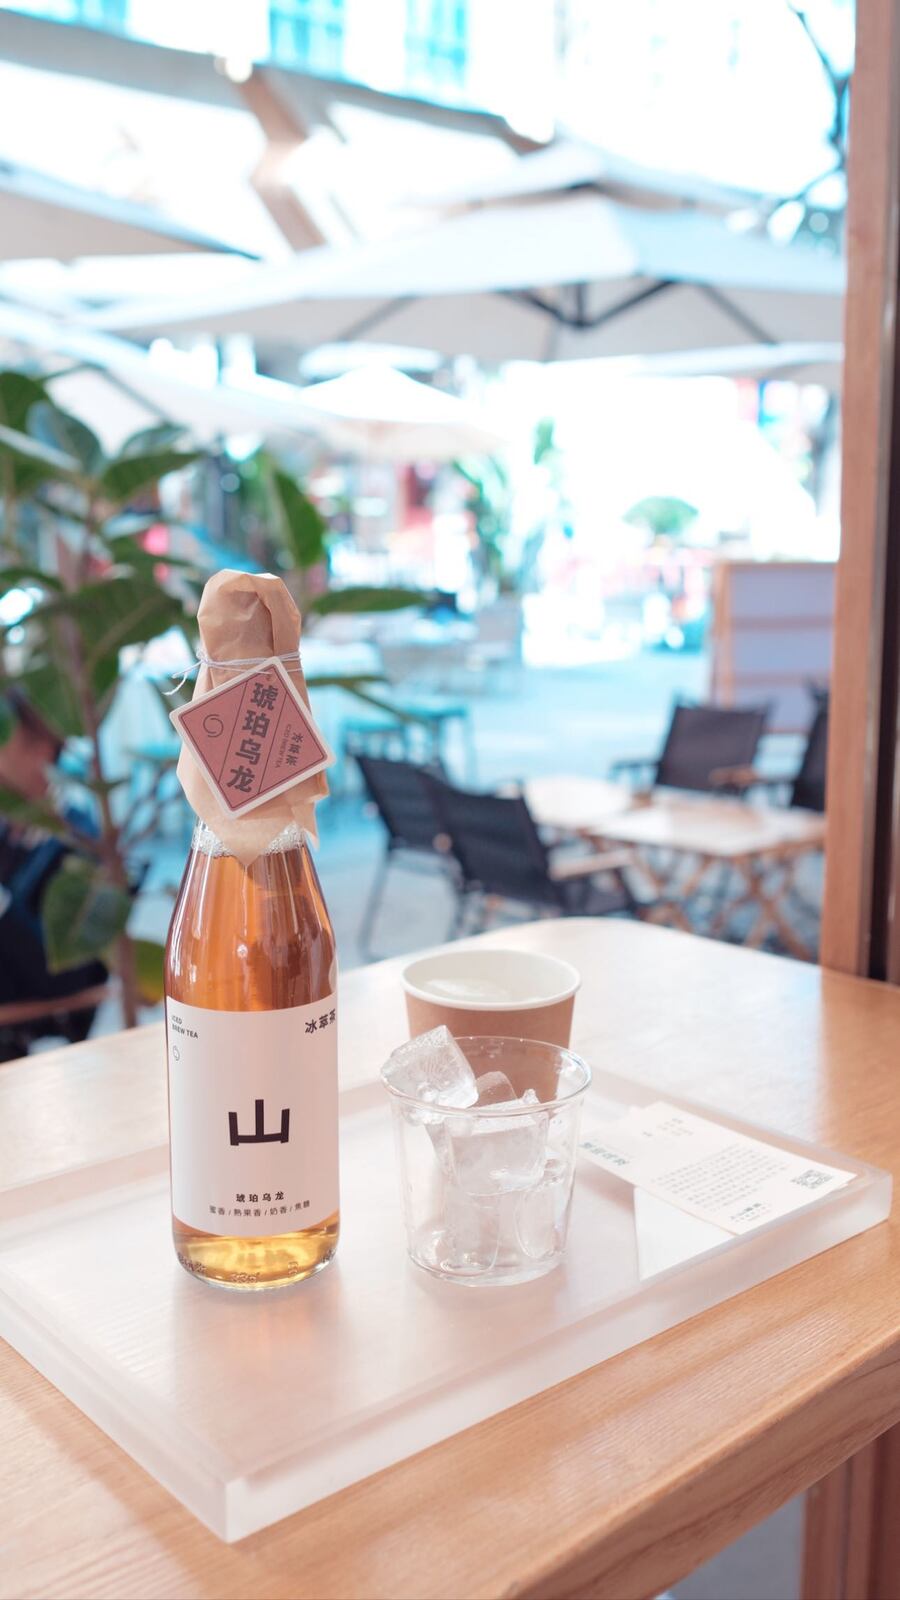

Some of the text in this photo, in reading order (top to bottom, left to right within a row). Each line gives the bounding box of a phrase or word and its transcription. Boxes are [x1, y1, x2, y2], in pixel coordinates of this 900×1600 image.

[226, 683, 279, 793] 琥珀乌龙
[186, 1029, 199, 1039] TEA
[228, 1099, 290, 1146] 山
[236, 1191, 284, 1203] 琥珀乌龙
